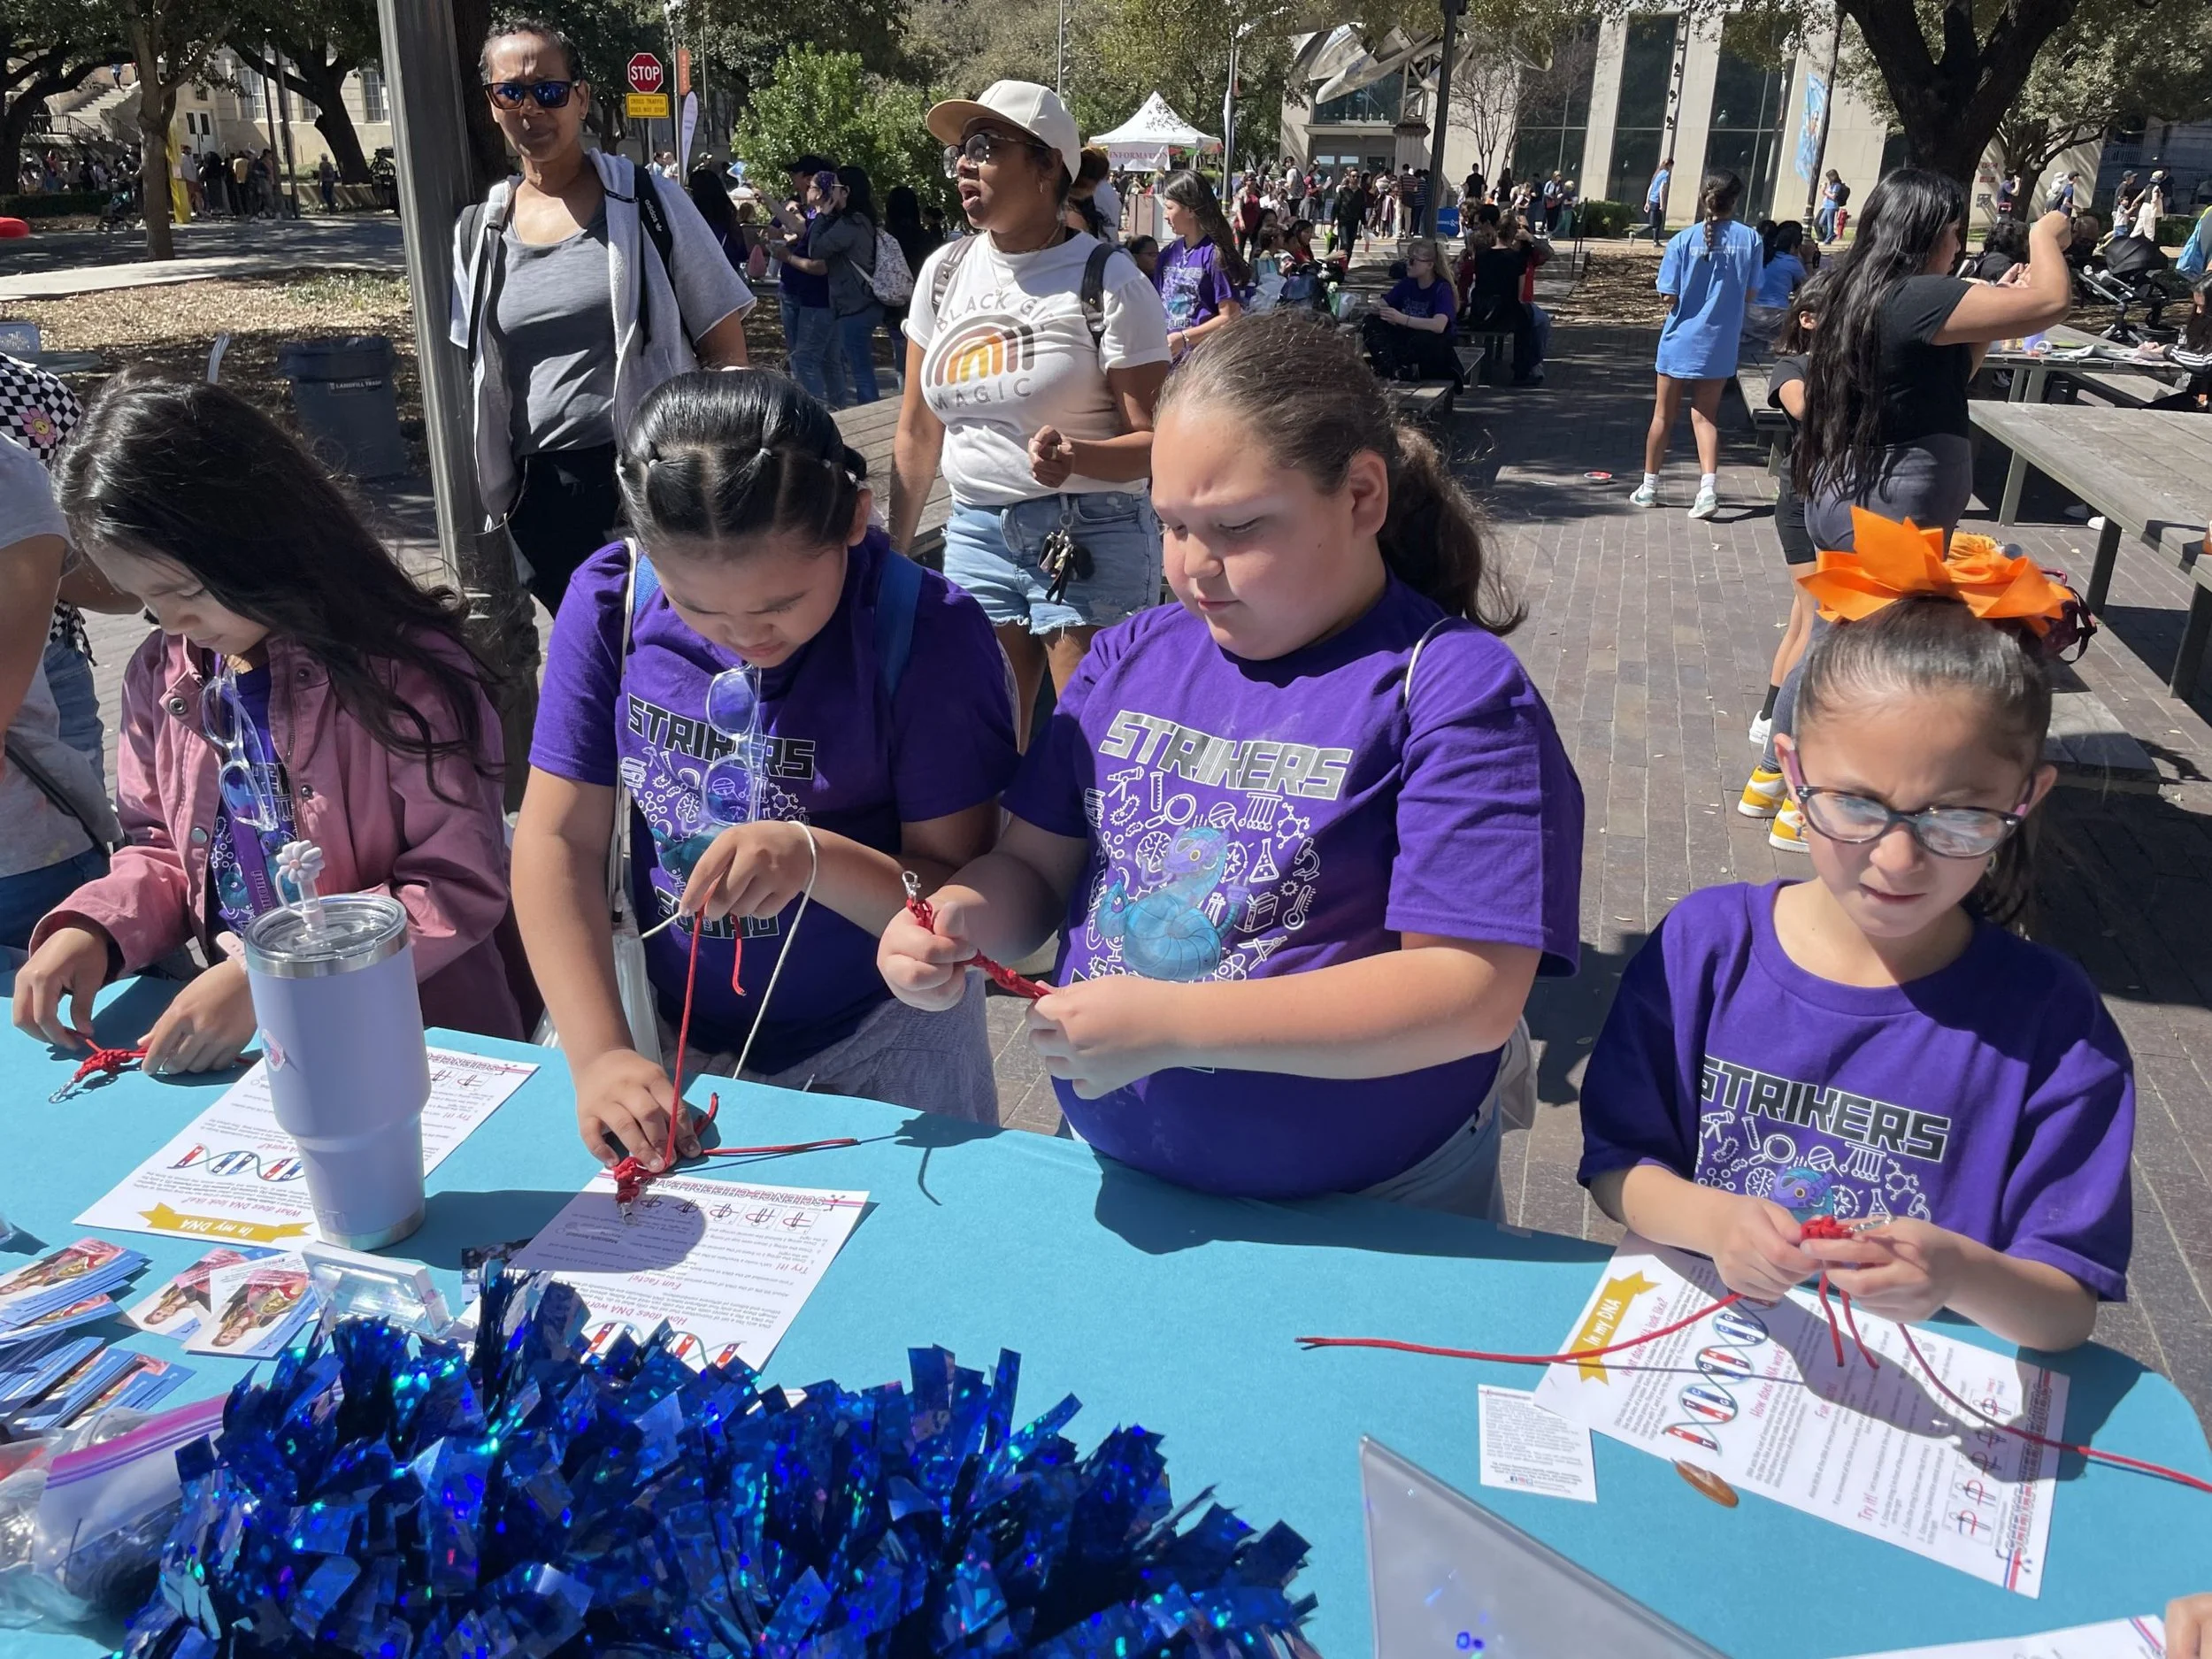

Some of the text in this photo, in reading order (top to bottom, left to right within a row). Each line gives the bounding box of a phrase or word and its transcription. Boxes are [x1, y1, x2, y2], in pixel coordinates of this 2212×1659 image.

[631, 66, 660, 81] STOP
[645, 199, 658, 223] adidas
[936, 293, 1007, 333] BLACK
[933, 377, 1033, 411] MAGIC
[1099, 710, 1353, 801] STRIKERS
[432, 1056, 499, 1071] SCIENCE
[455, 1112, 472, 1121] Try
[227, 1201, 250, 1210] DNA
[752, 1191, 825, 1205] SCIENCE
[273, 1208, 303, 1217] What
[177, 1218, 254, 1236] In my DNA
[790, 1263, 808, 1274] Try
[626, 1274, 681, 1290] Fun facts!
[608, 1304, 634, 1316] DNA
[634, 1310, 661, 1320] does
[1583, 1297, 1620, 1345] In my DNA
[1757, 1381, 1771, 1399] does
[1750, 1399, 1765, 1417] How
[1815, 1402, 1829, 1417] Fun
[1858, 1503, 1877, 1523] Try
[2008, 1486, 2032, 1555] SCIENCE
